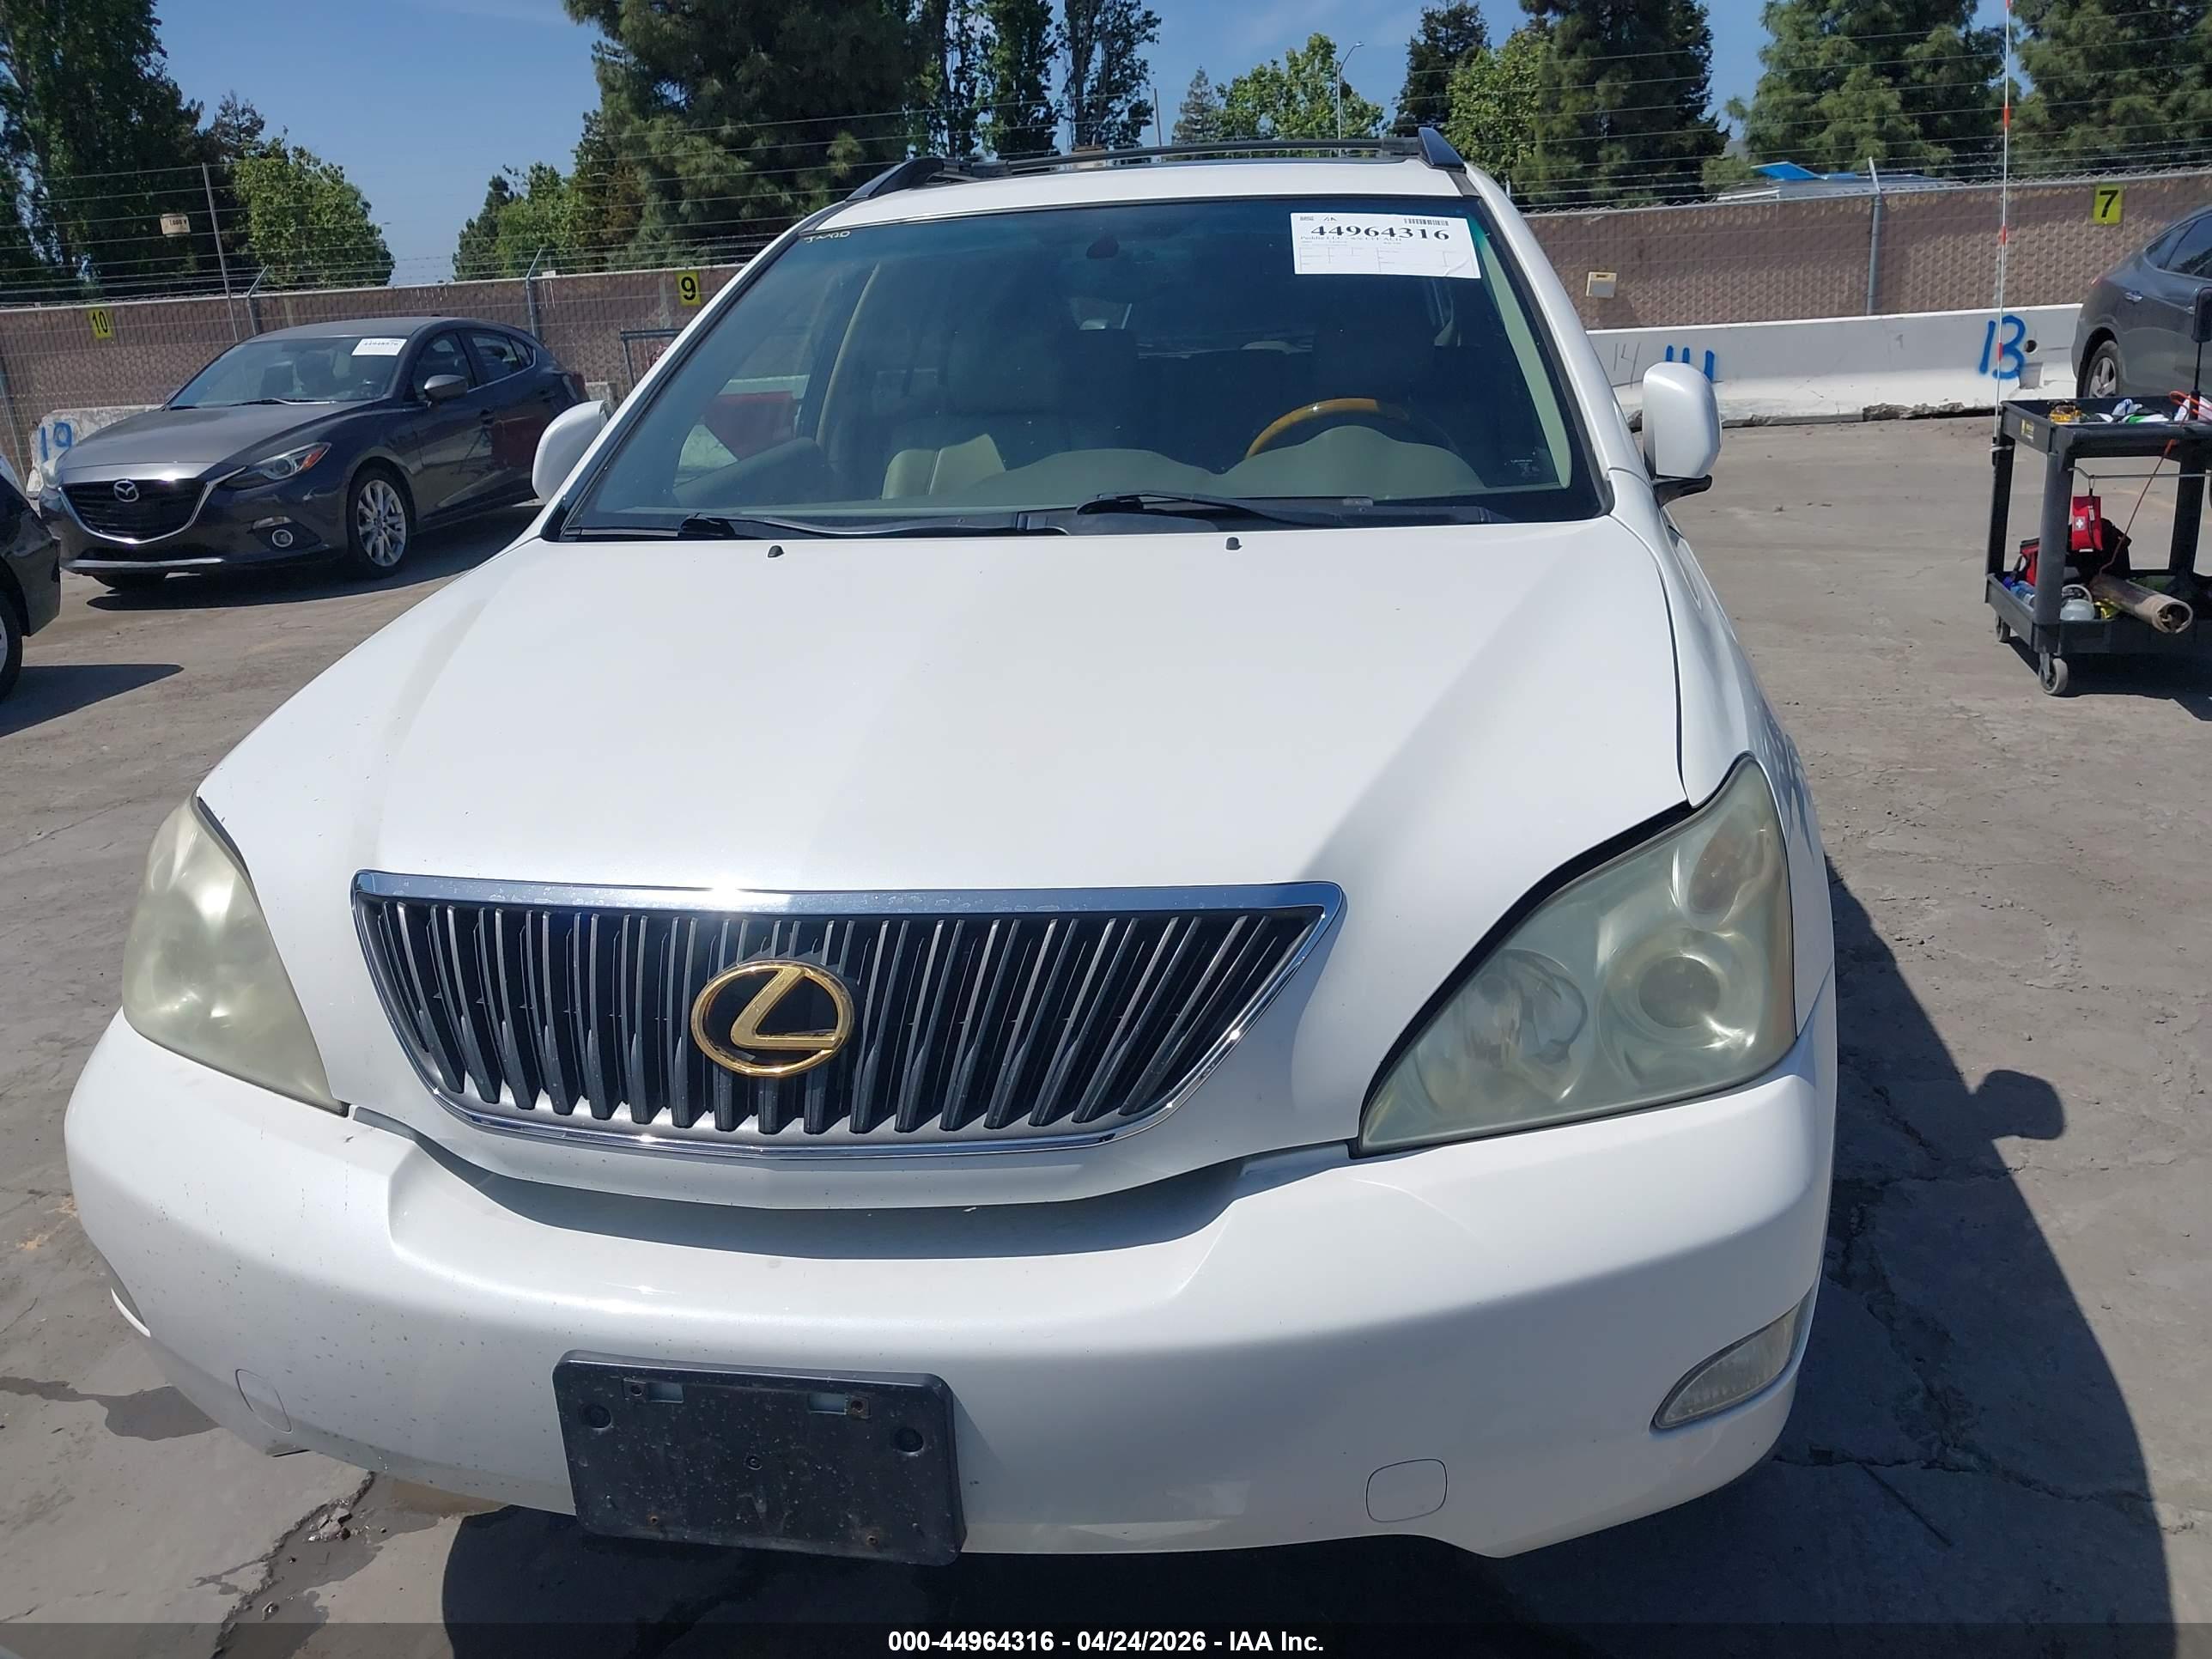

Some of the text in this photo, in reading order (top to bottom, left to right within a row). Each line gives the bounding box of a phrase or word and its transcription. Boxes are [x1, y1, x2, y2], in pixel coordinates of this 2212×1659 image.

[2099, 189, 2119, 218] 7
[1310, 224, 1450, 240] 44964316
[680, 276, 696, 301] 9
[92, 311, 108, 334] 10
[1978, 314, 2027, 380] 13
